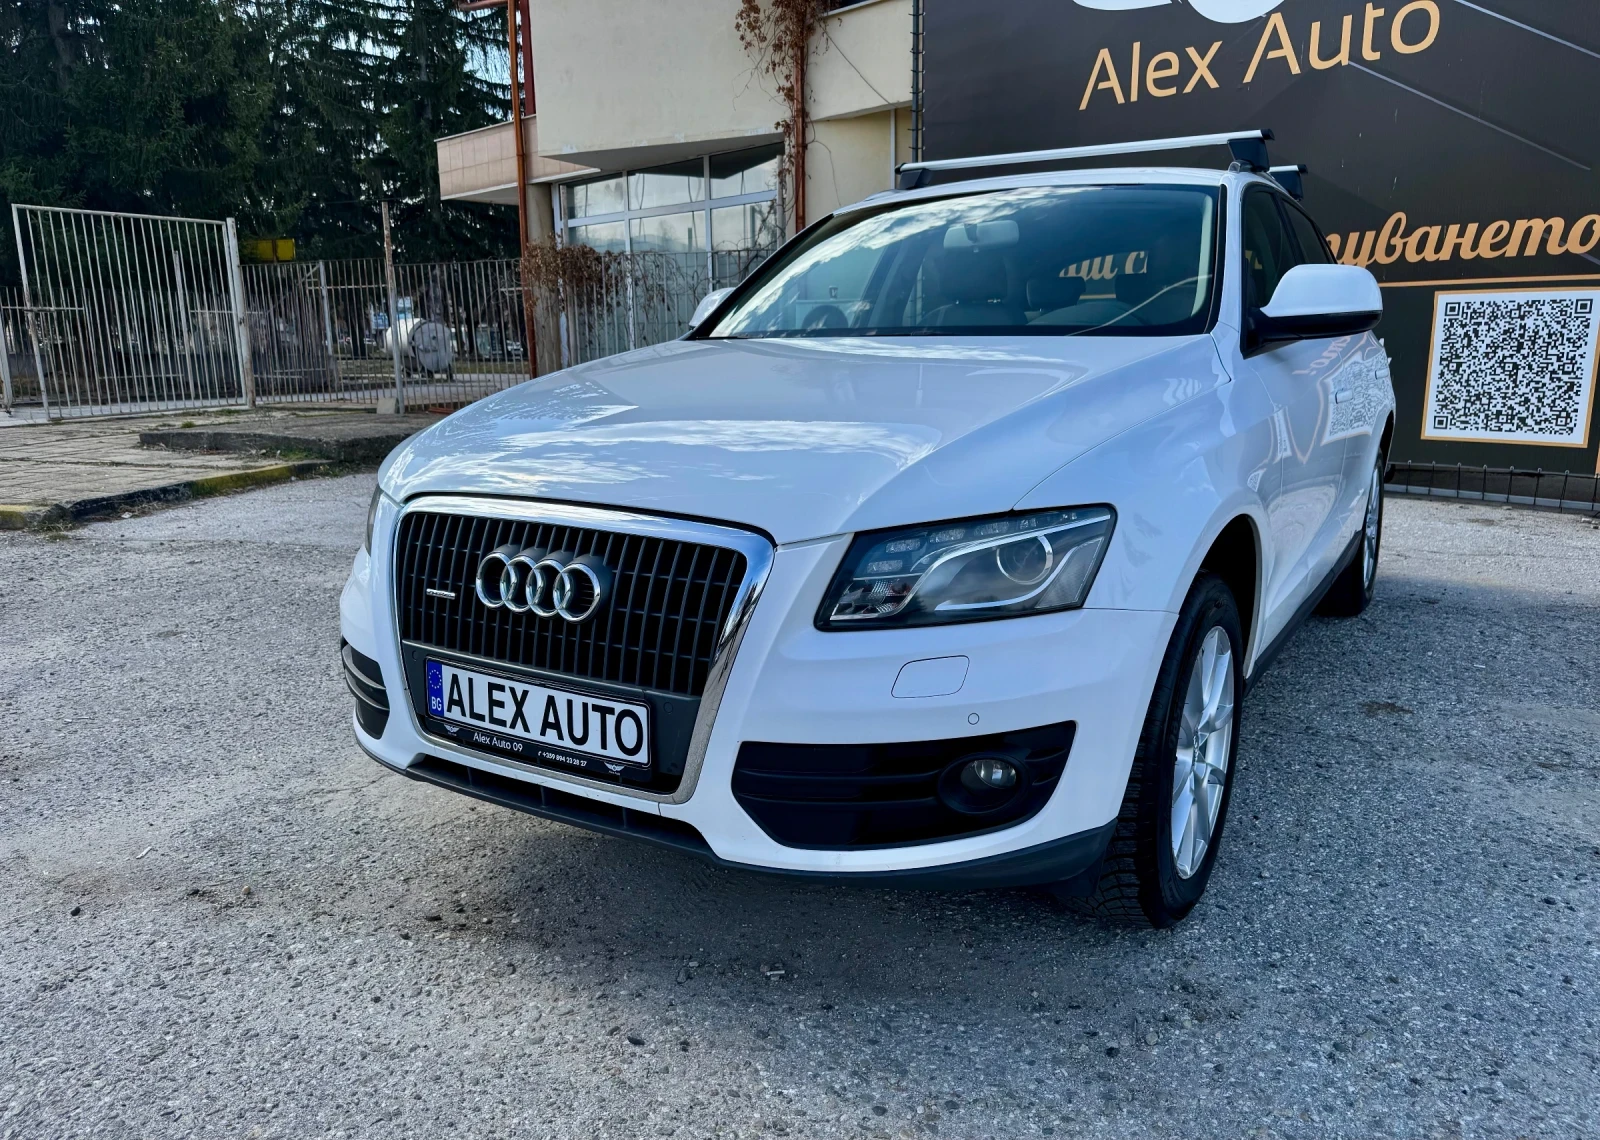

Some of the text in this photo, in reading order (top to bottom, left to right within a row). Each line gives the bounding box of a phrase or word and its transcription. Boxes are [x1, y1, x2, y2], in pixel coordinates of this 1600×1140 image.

[1079, 0, 1441, 111] Alex Auto
[431, 696, 442, 712] BG
[446, 673, 644, 757] ALEX AUTO
[473, 732, 523, 752] Alex Auto 09
